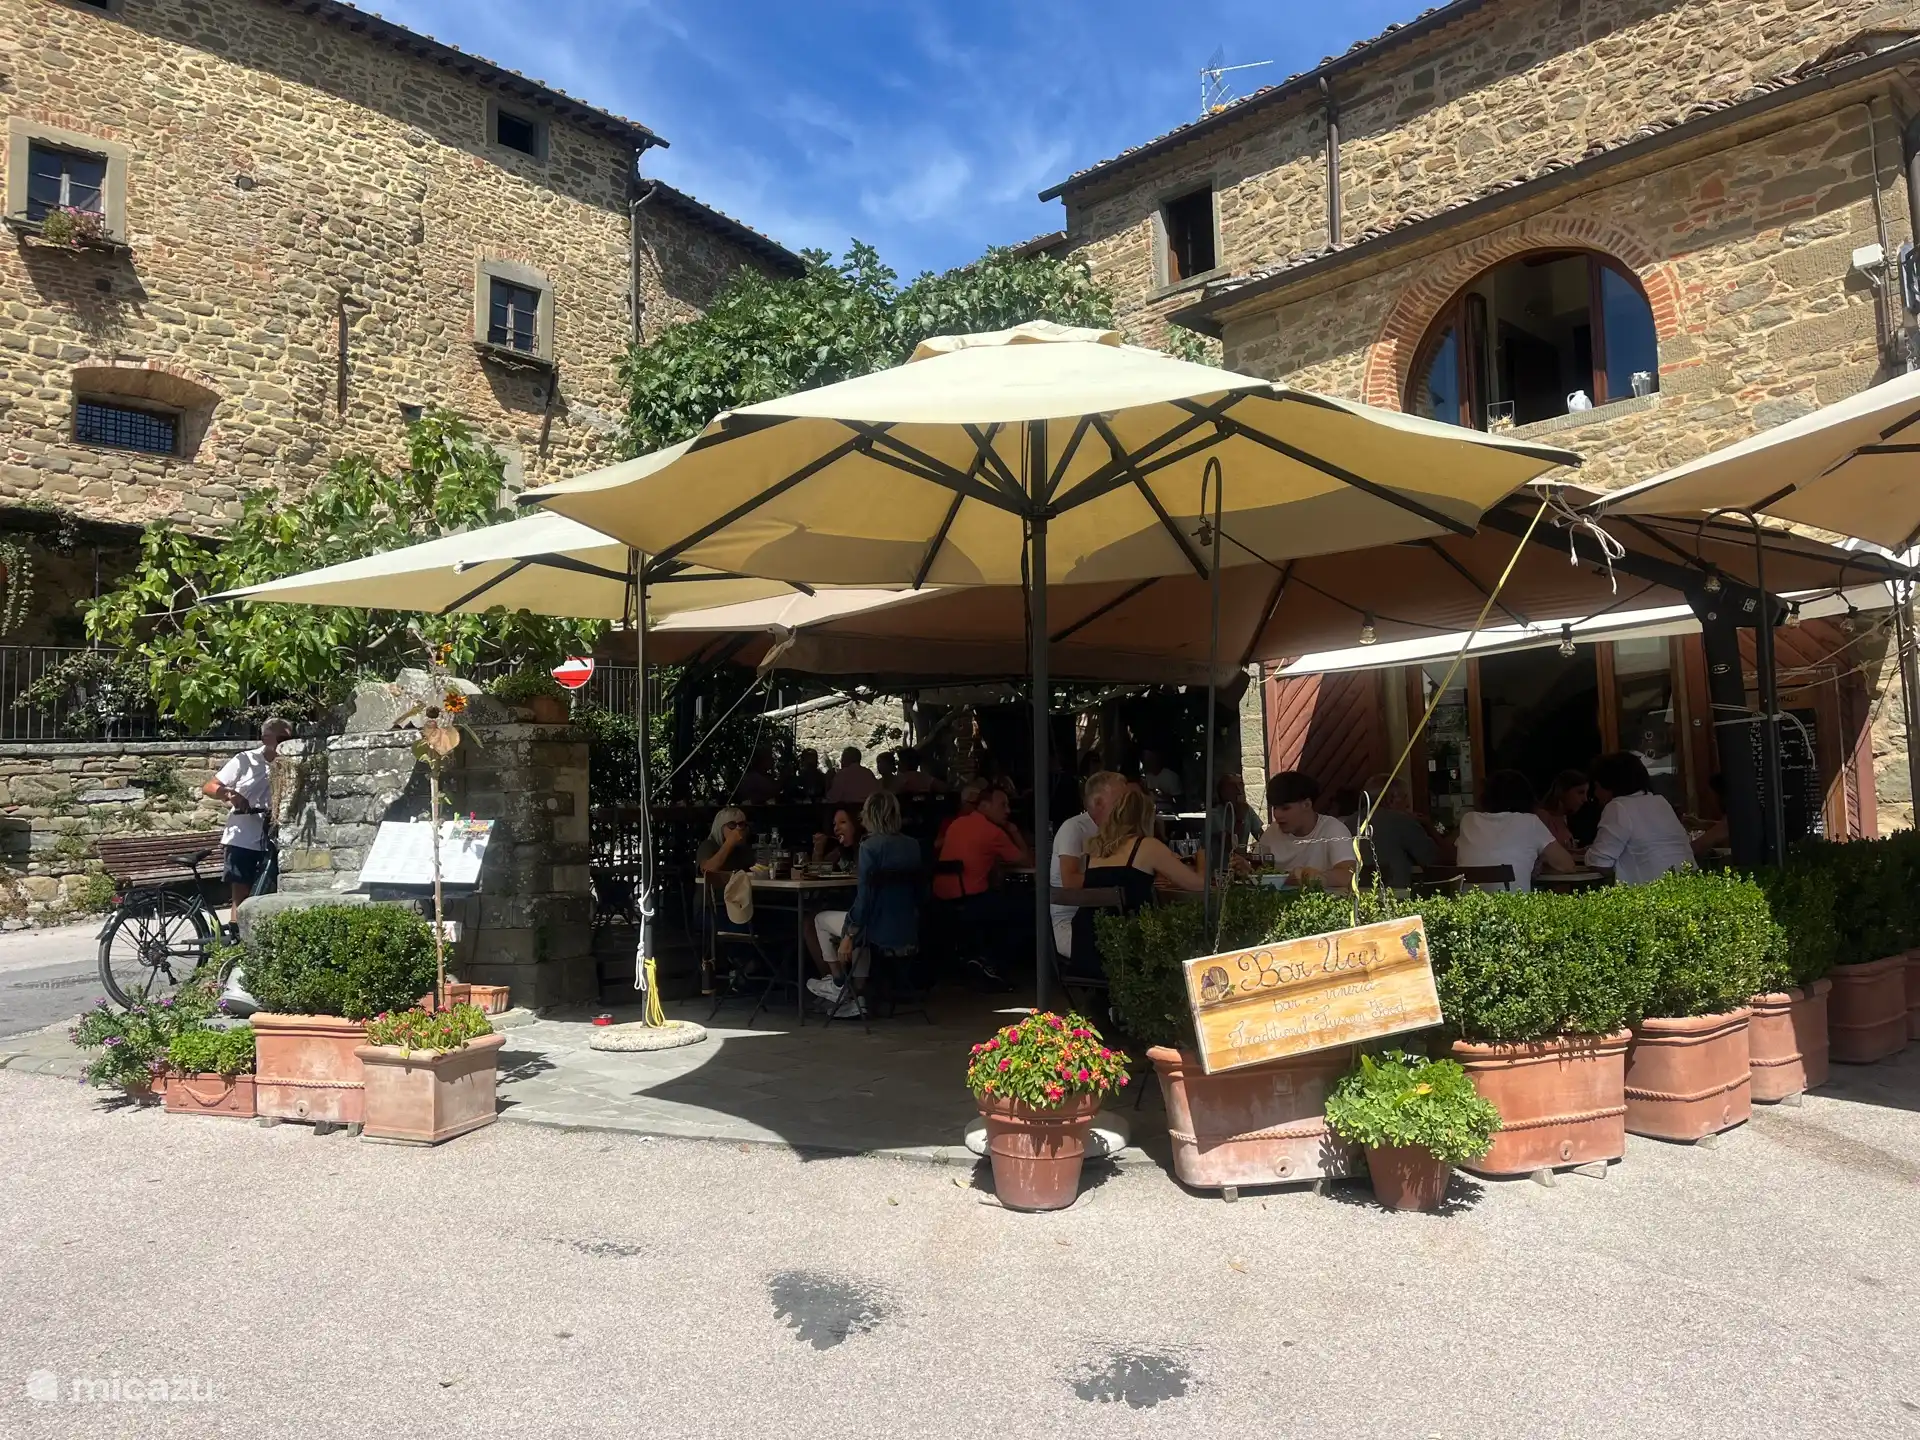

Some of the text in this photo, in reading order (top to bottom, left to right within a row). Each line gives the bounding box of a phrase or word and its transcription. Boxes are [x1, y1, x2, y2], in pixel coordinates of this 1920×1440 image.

[1238, 936, 1386, 991] Bar Ucci
[1228, 997, 1407, 1049] Traditional Tuscan Food
[1273, 981, 1377, 1014] bar vineria
